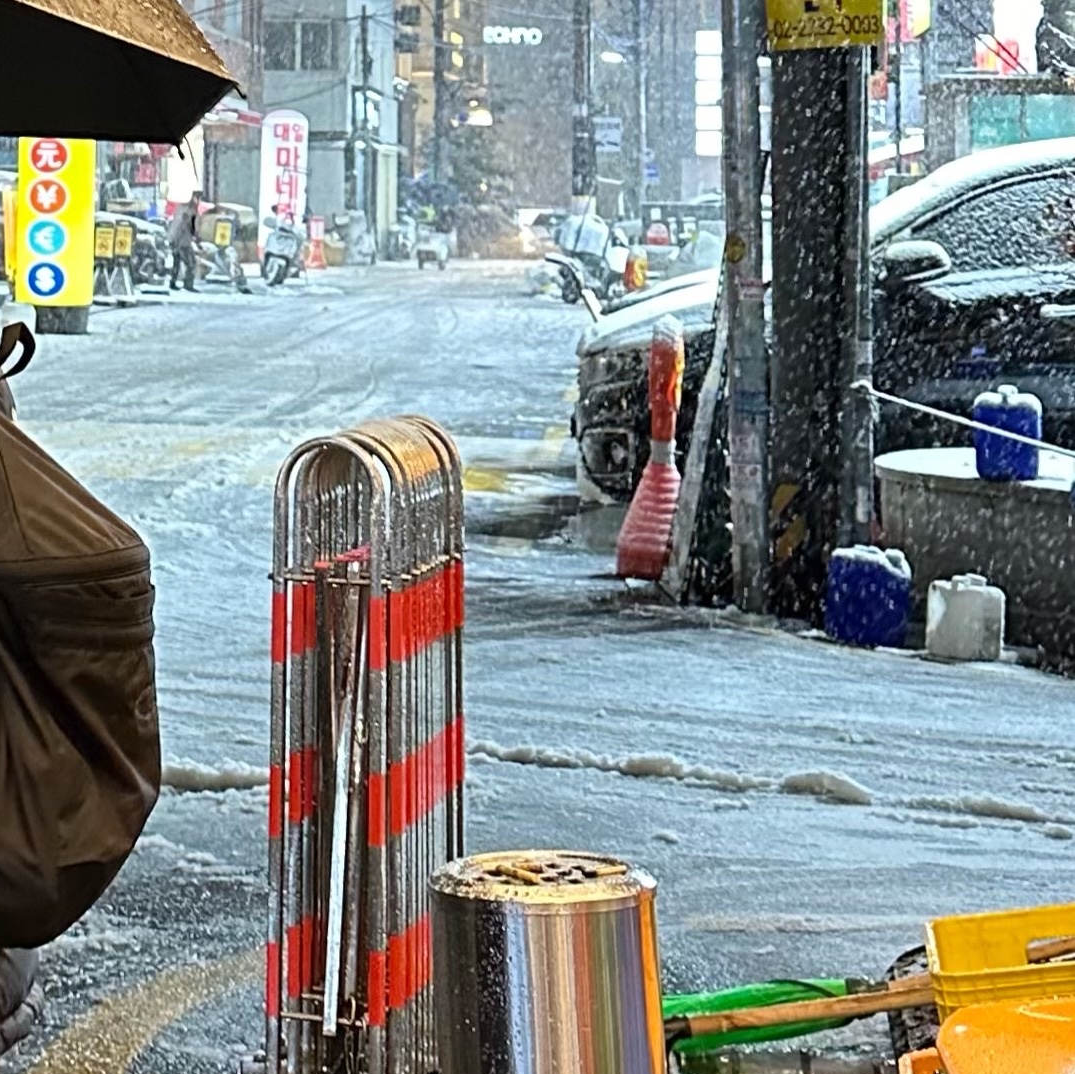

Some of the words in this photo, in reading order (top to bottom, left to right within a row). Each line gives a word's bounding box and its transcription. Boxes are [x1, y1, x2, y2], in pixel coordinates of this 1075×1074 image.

[36, 142, 63, 169] 元
[36, 184, 59, 210] ¥
[34, 225, 56, 251] €
